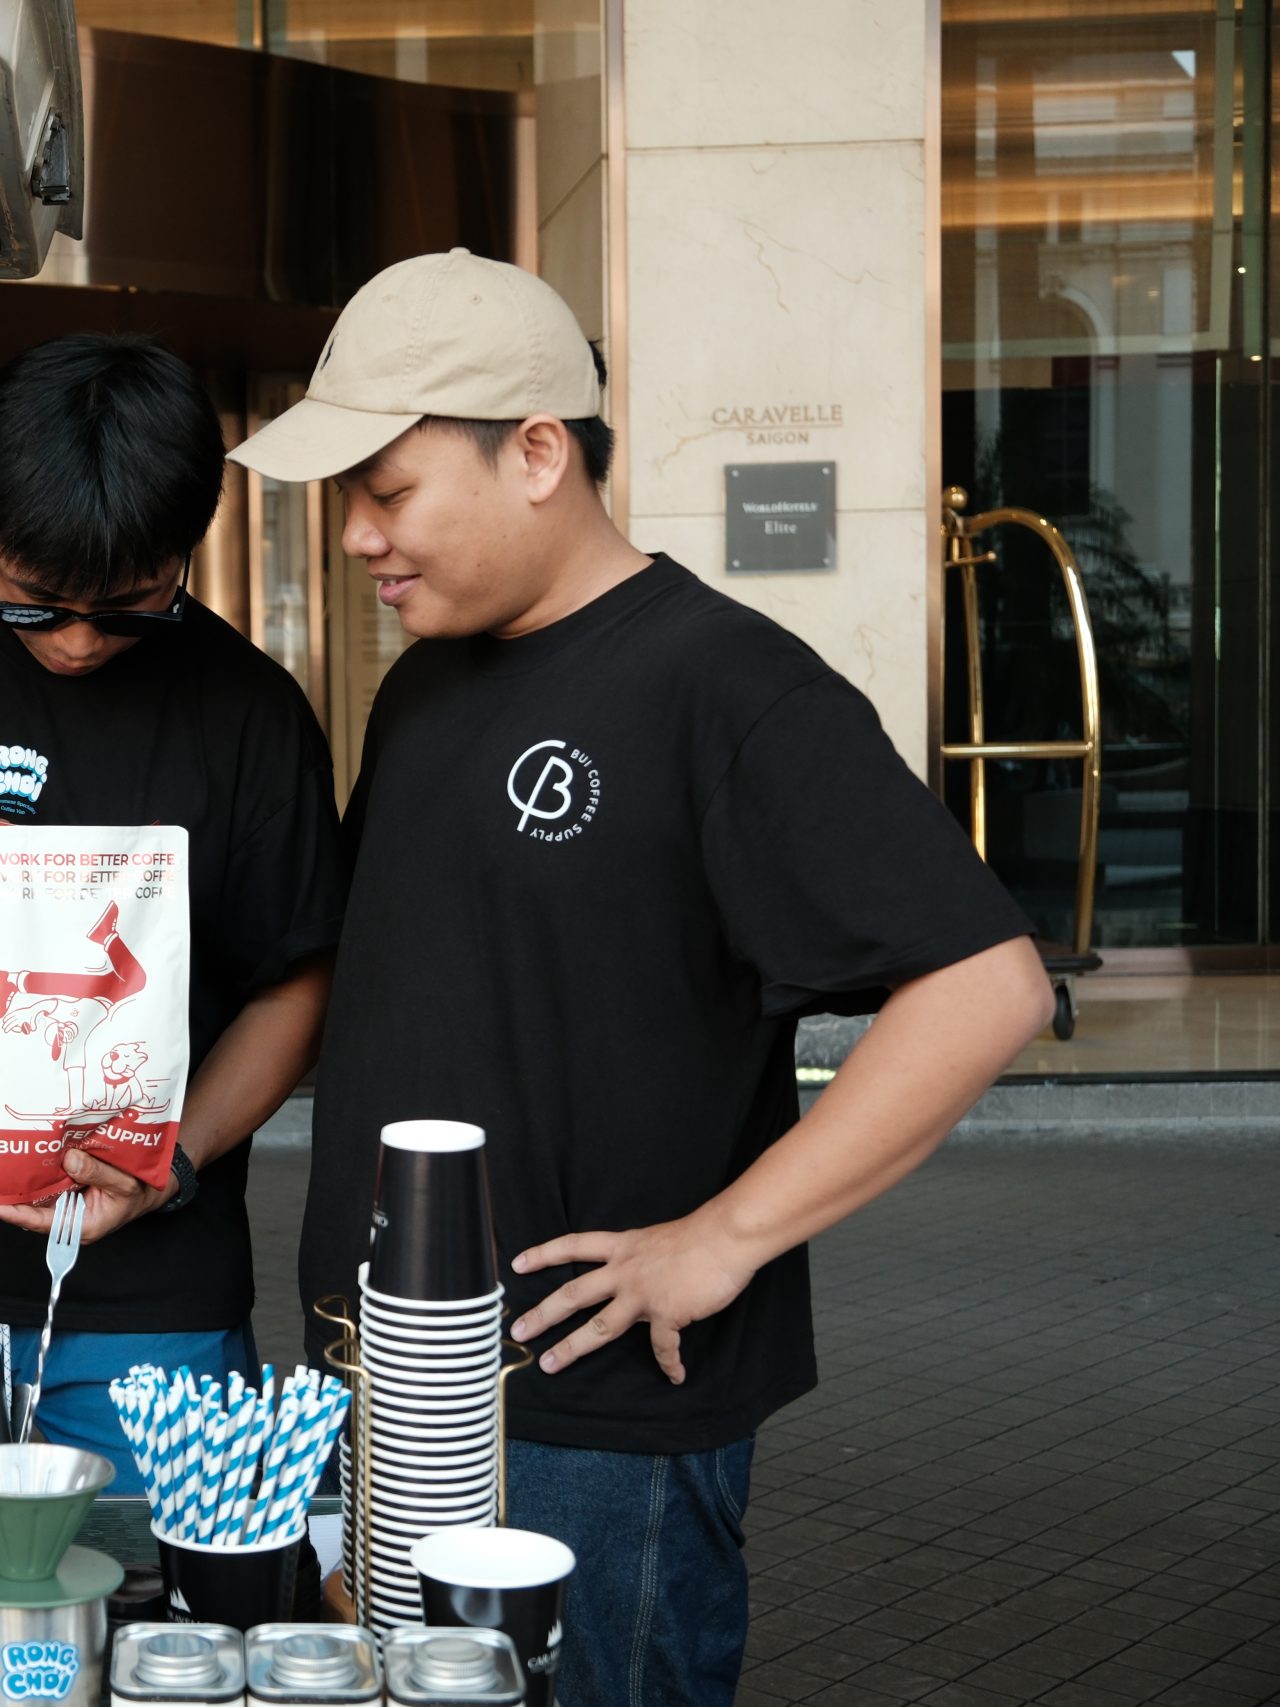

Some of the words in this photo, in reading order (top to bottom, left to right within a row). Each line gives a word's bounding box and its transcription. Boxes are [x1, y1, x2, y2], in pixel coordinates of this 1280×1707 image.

[711, 404, 843, 425] CARAVELLE
[746, 431, 810, 446] SAIGON
[764, 520, 797, 535] Elite
[570, 748, 592, 768] BUI
[580, 769, 601, 822] COFFEE
[530, 823, 583, 842] SUPPLY
[44, 854, 76, 866] FOR
[80, 854, 129, 866] BETTER
[131, 853, 175, 866] COFFE
[44, 870, 76, 883] FOR
[95, 1123, 162, 1147] SUPPLY
[3, 1642, 78, 1673] RONG
